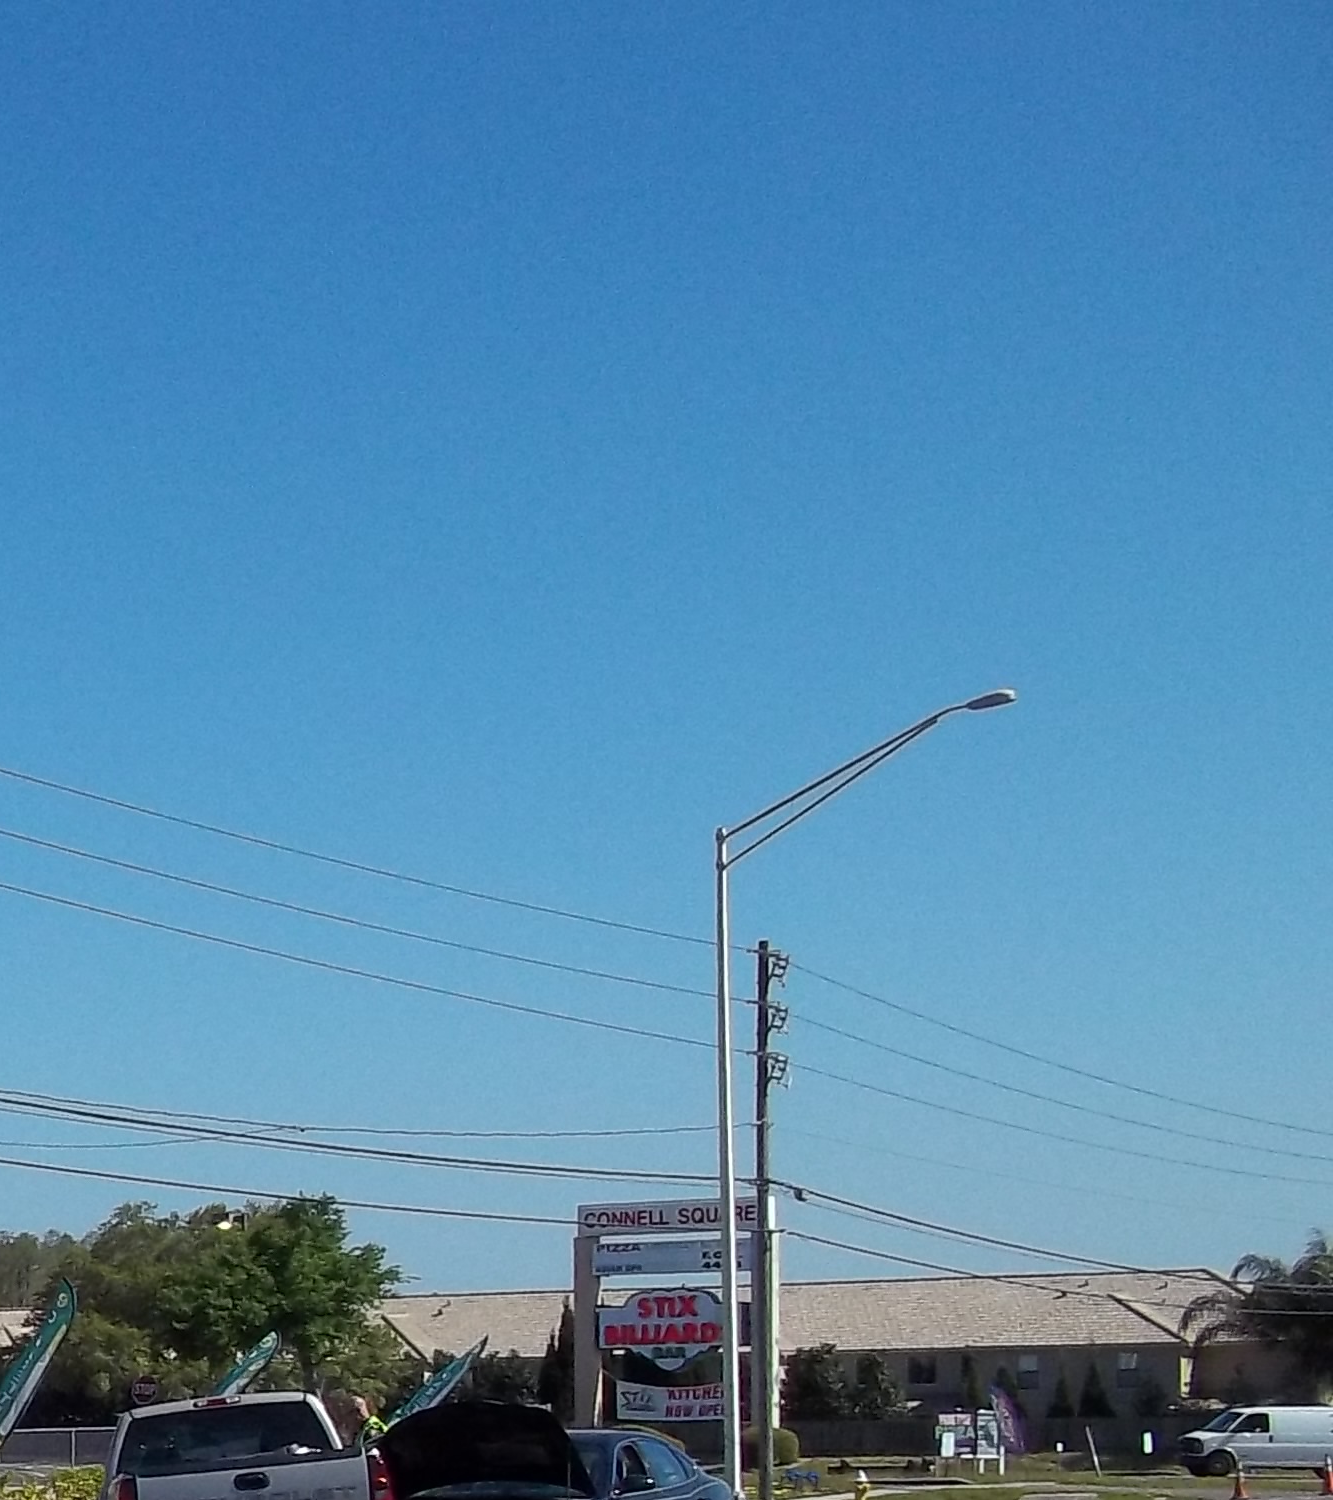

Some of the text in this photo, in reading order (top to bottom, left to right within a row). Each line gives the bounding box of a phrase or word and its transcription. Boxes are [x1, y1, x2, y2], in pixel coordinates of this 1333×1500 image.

[583, 1205, 757, 1229] CONNELL SQURE
[637, 1296, 699, 1319] STIX
[666, 1386, 724, 1401] KITCHE
[664, 1402, 724, 1418] NOW OPE
